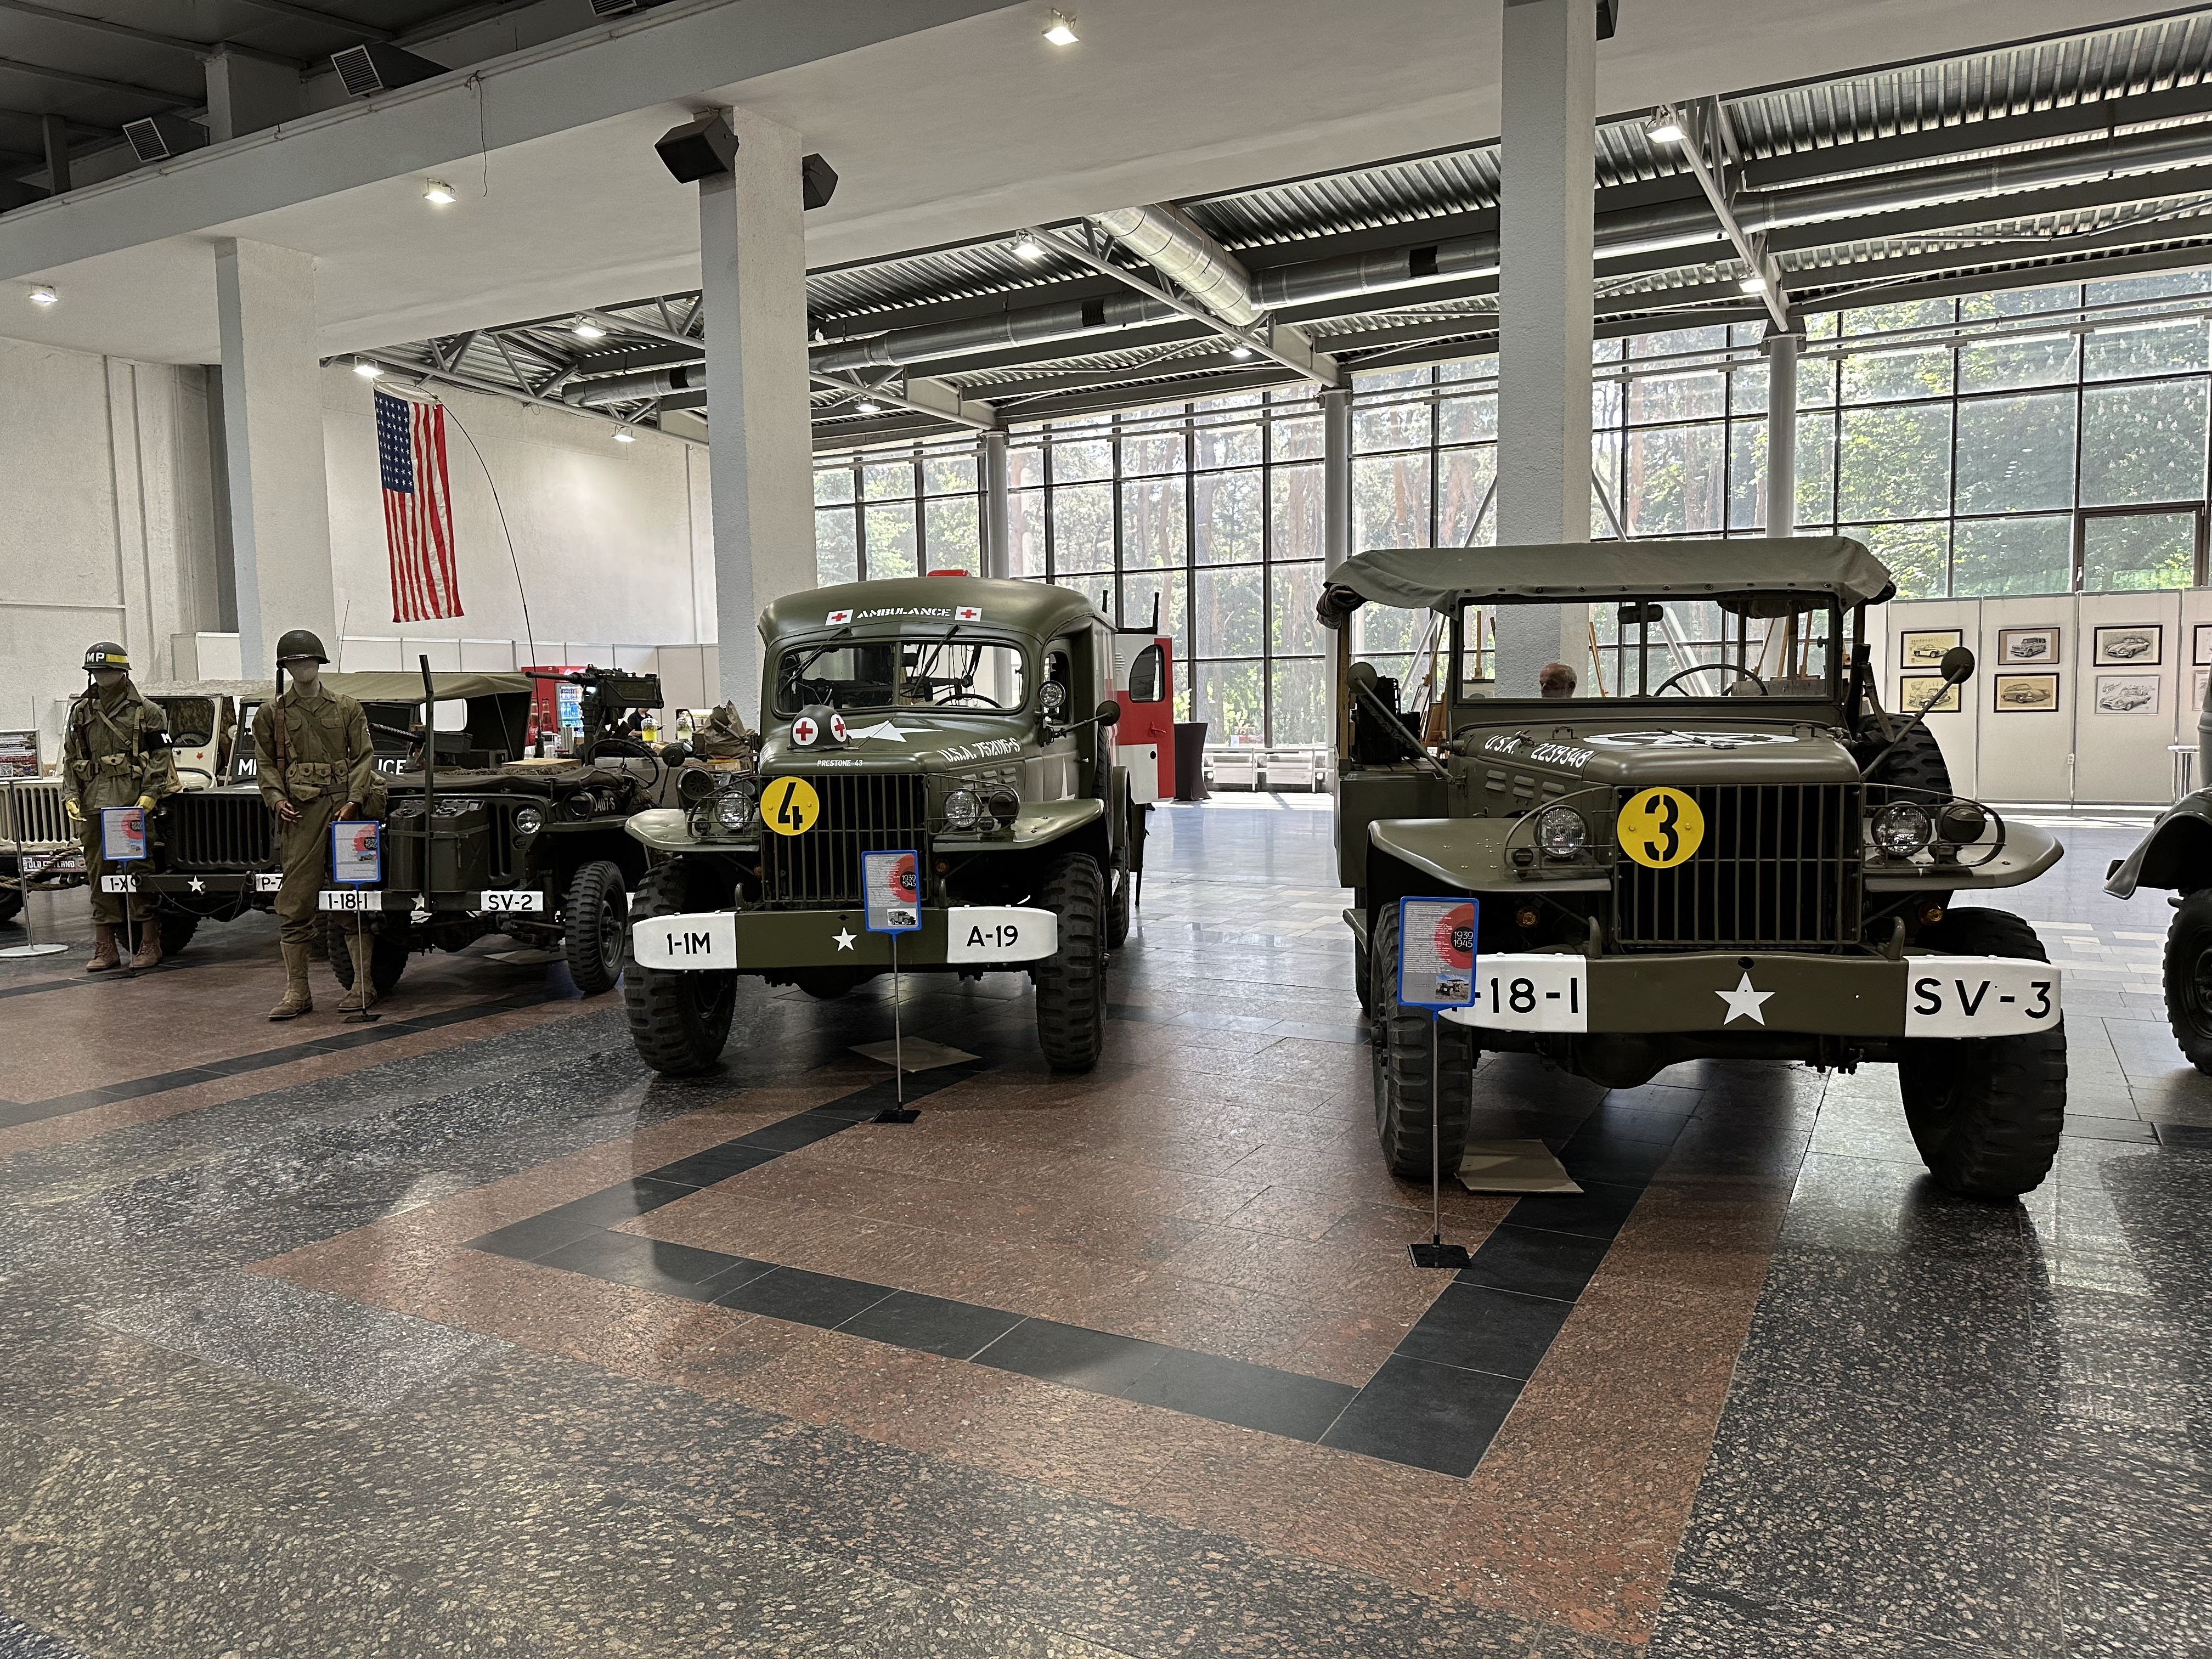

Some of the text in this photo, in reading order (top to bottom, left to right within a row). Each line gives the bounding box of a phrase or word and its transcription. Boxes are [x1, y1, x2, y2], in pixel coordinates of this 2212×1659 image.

[856, 607, 951, 619] AMBULANCE
[87, 652, 105, 662] MP
[161, 733, 173, 744] M
[936, 746, 977, 763] U.S.A.
[1485, 735, 1594, 768] U.S.A. 2239348
[377, 759, 407, 775] ICE
[777, 782, 803, 831] 4
[1644, 794, 1679, 862] 3
[488, 894, 533, 910] SV-2
[667, 925, 1018, 955] 1-1M A-19
[1453, 939, 1473, 948] 1945
[1454, 931, 1474, 940] 1939
[1913, 978, 2051, 1019] SV-3
